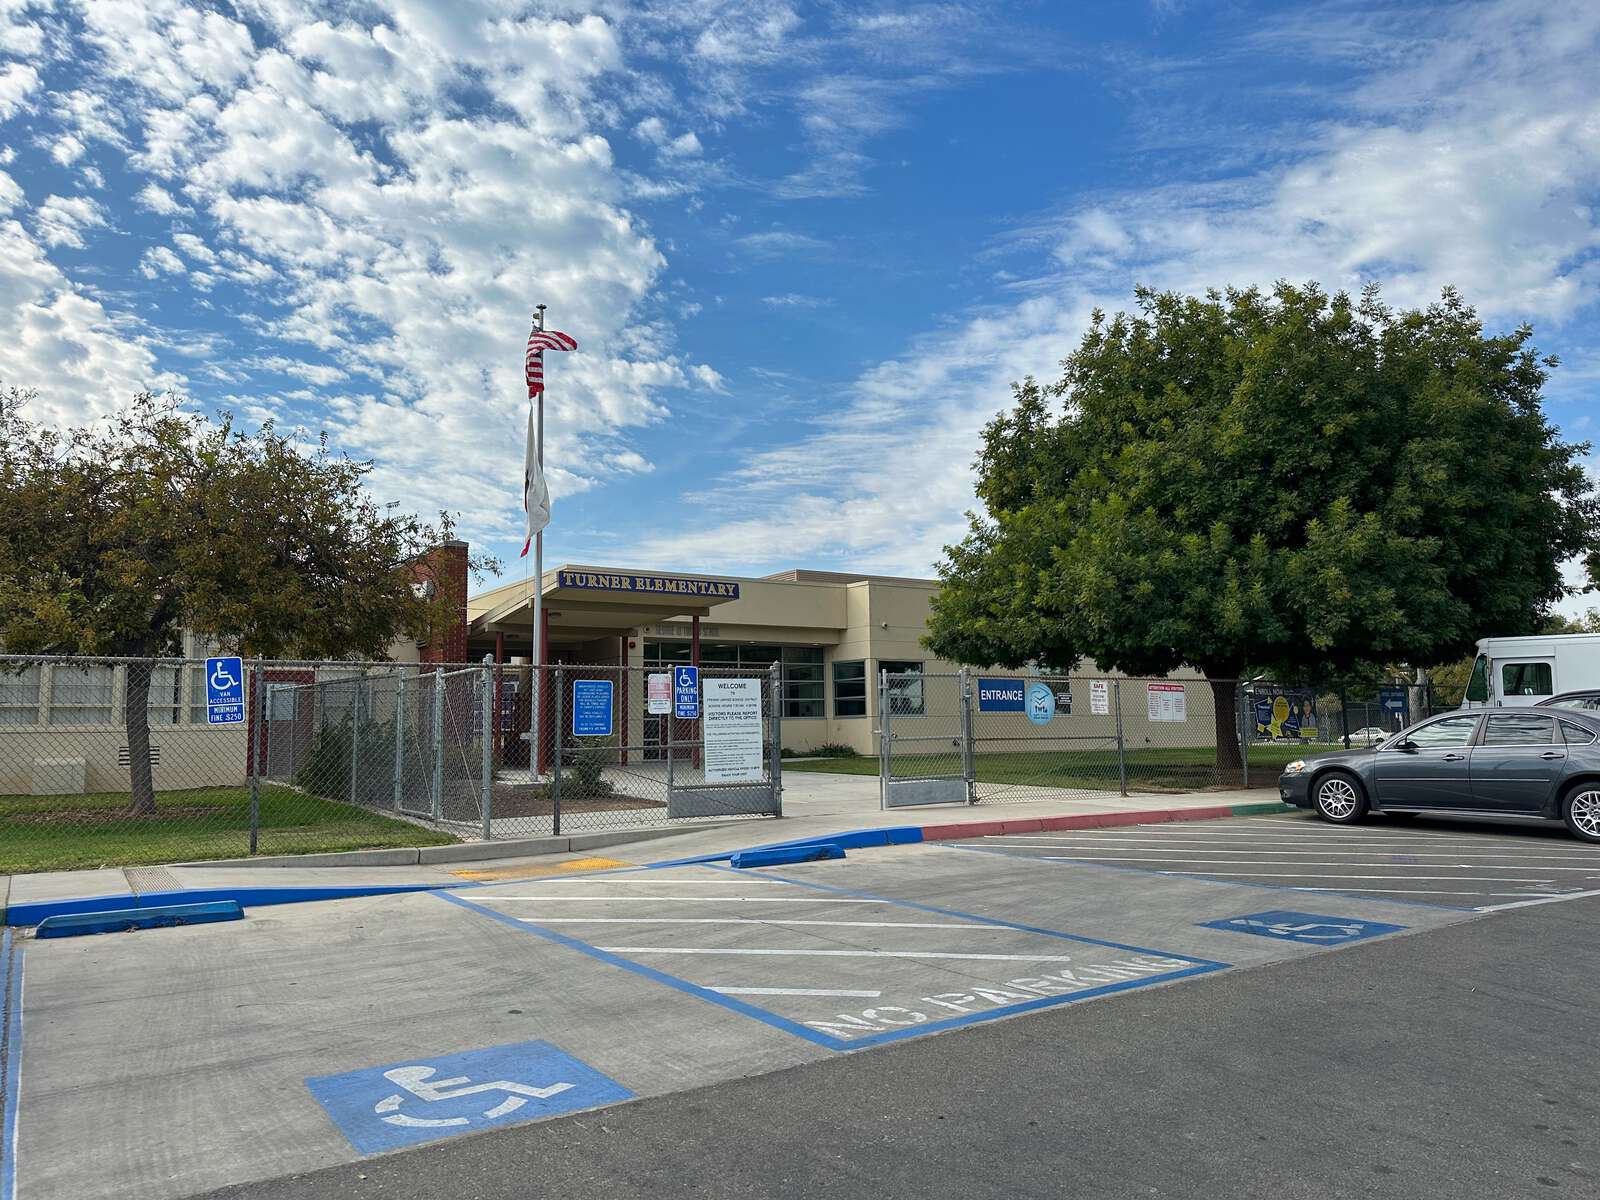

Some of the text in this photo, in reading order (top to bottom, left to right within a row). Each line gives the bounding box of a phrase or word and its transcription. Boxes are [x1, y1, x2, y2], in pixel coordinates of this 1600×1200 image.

[563, 572, 737, 596] TURNER ELEMENTARY
[676, 686, 697, 695] PARKING
[980, 690, 1023, 701] ENTRANCE
[210, 713, 242, 722] FINE $250
[804, 954, 1191, 1039] NO PARKING
